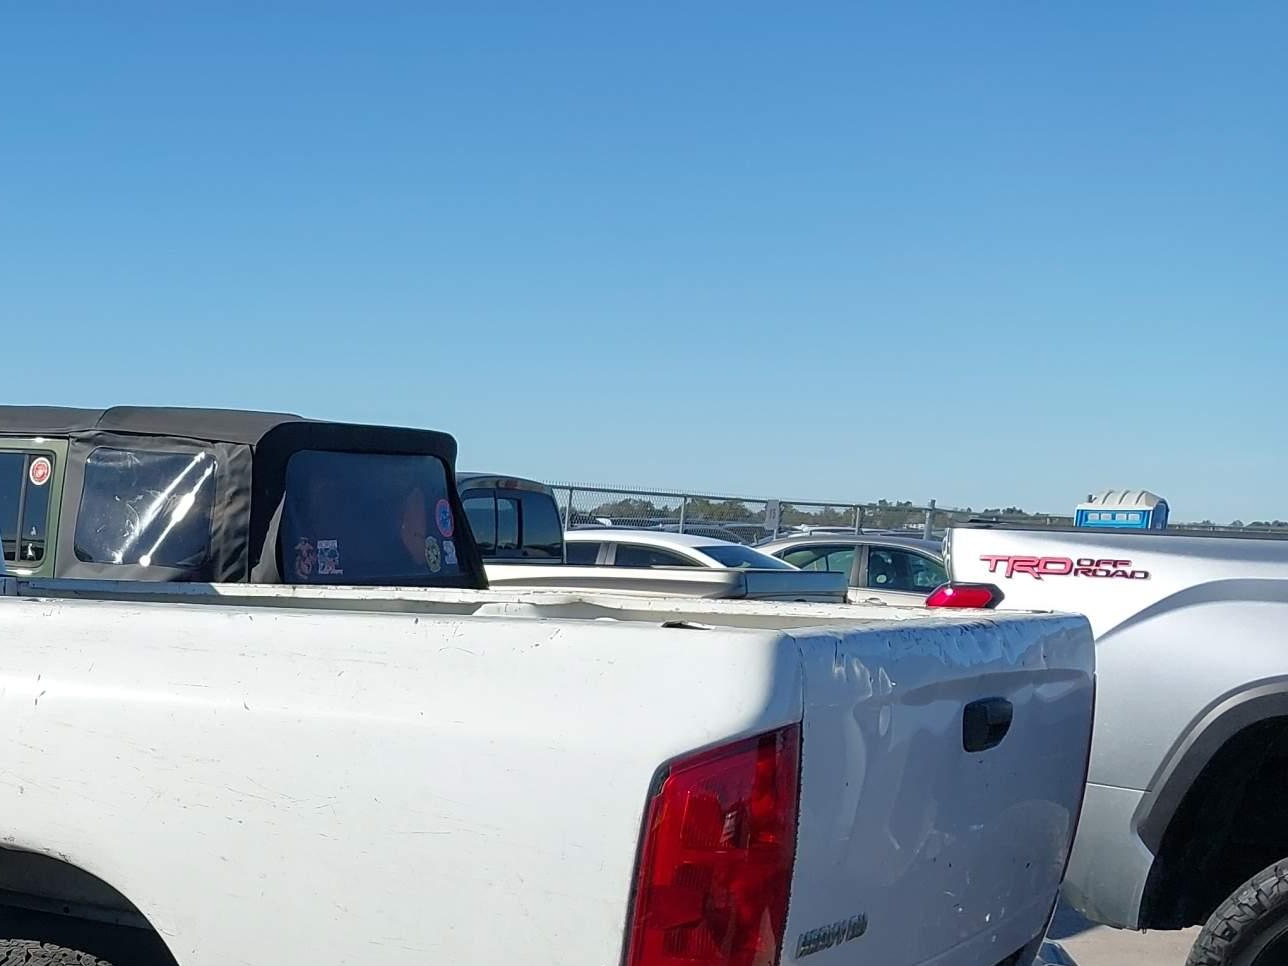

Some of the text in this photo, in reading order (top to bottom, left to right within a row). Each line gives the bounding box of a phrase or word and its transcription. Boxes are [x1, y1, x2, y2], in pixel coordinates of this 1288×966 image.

[980, 554, 1074, 581] TRD
[1076, 558, 1132, 568] OFF
[1073, 567, 1150, 580] ROAD
